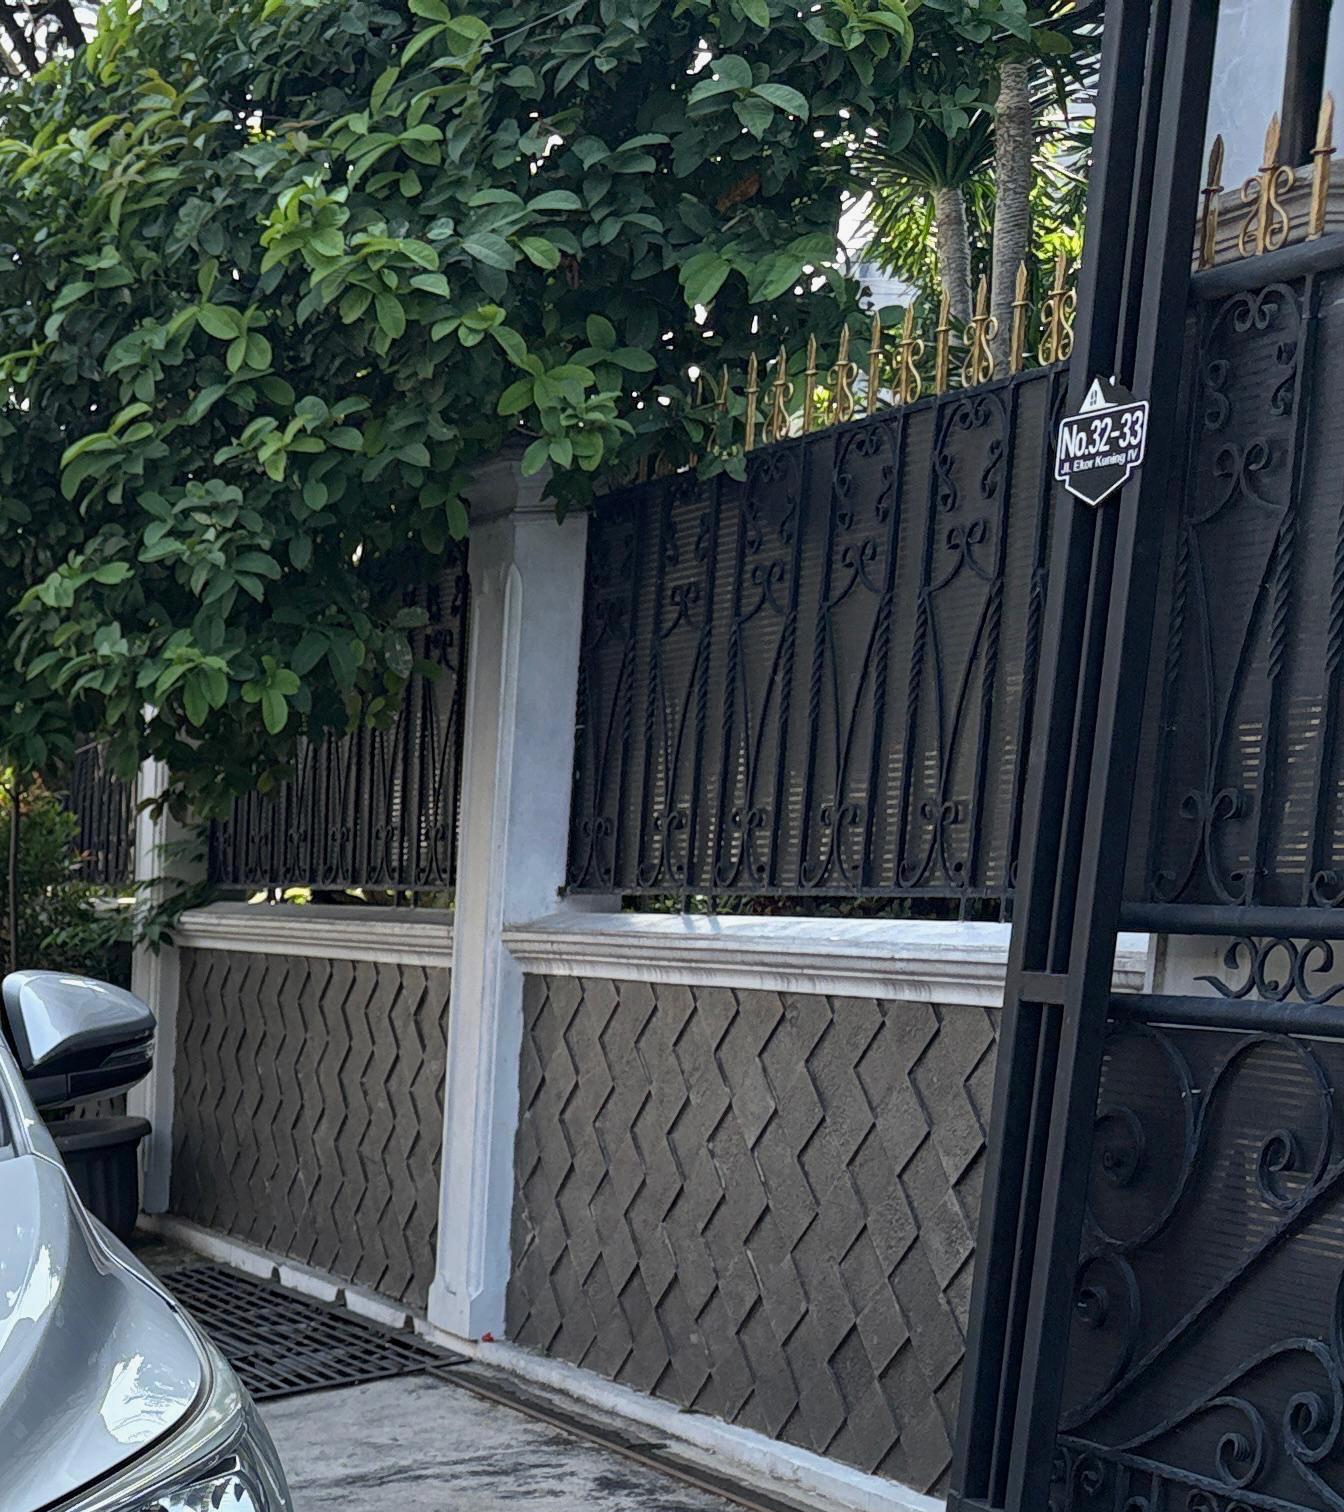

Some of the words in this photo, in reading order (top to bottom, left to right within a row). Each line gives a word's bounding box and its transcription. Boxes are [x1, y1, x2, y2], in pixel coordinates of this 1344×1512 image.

[1061, 410, 1143, 460] No.32-33
[1073, 458, 1093, 472] Ekor
[1095, 452, 1126, 467] Kuning
[1127, 448, 1139, 461] IV
